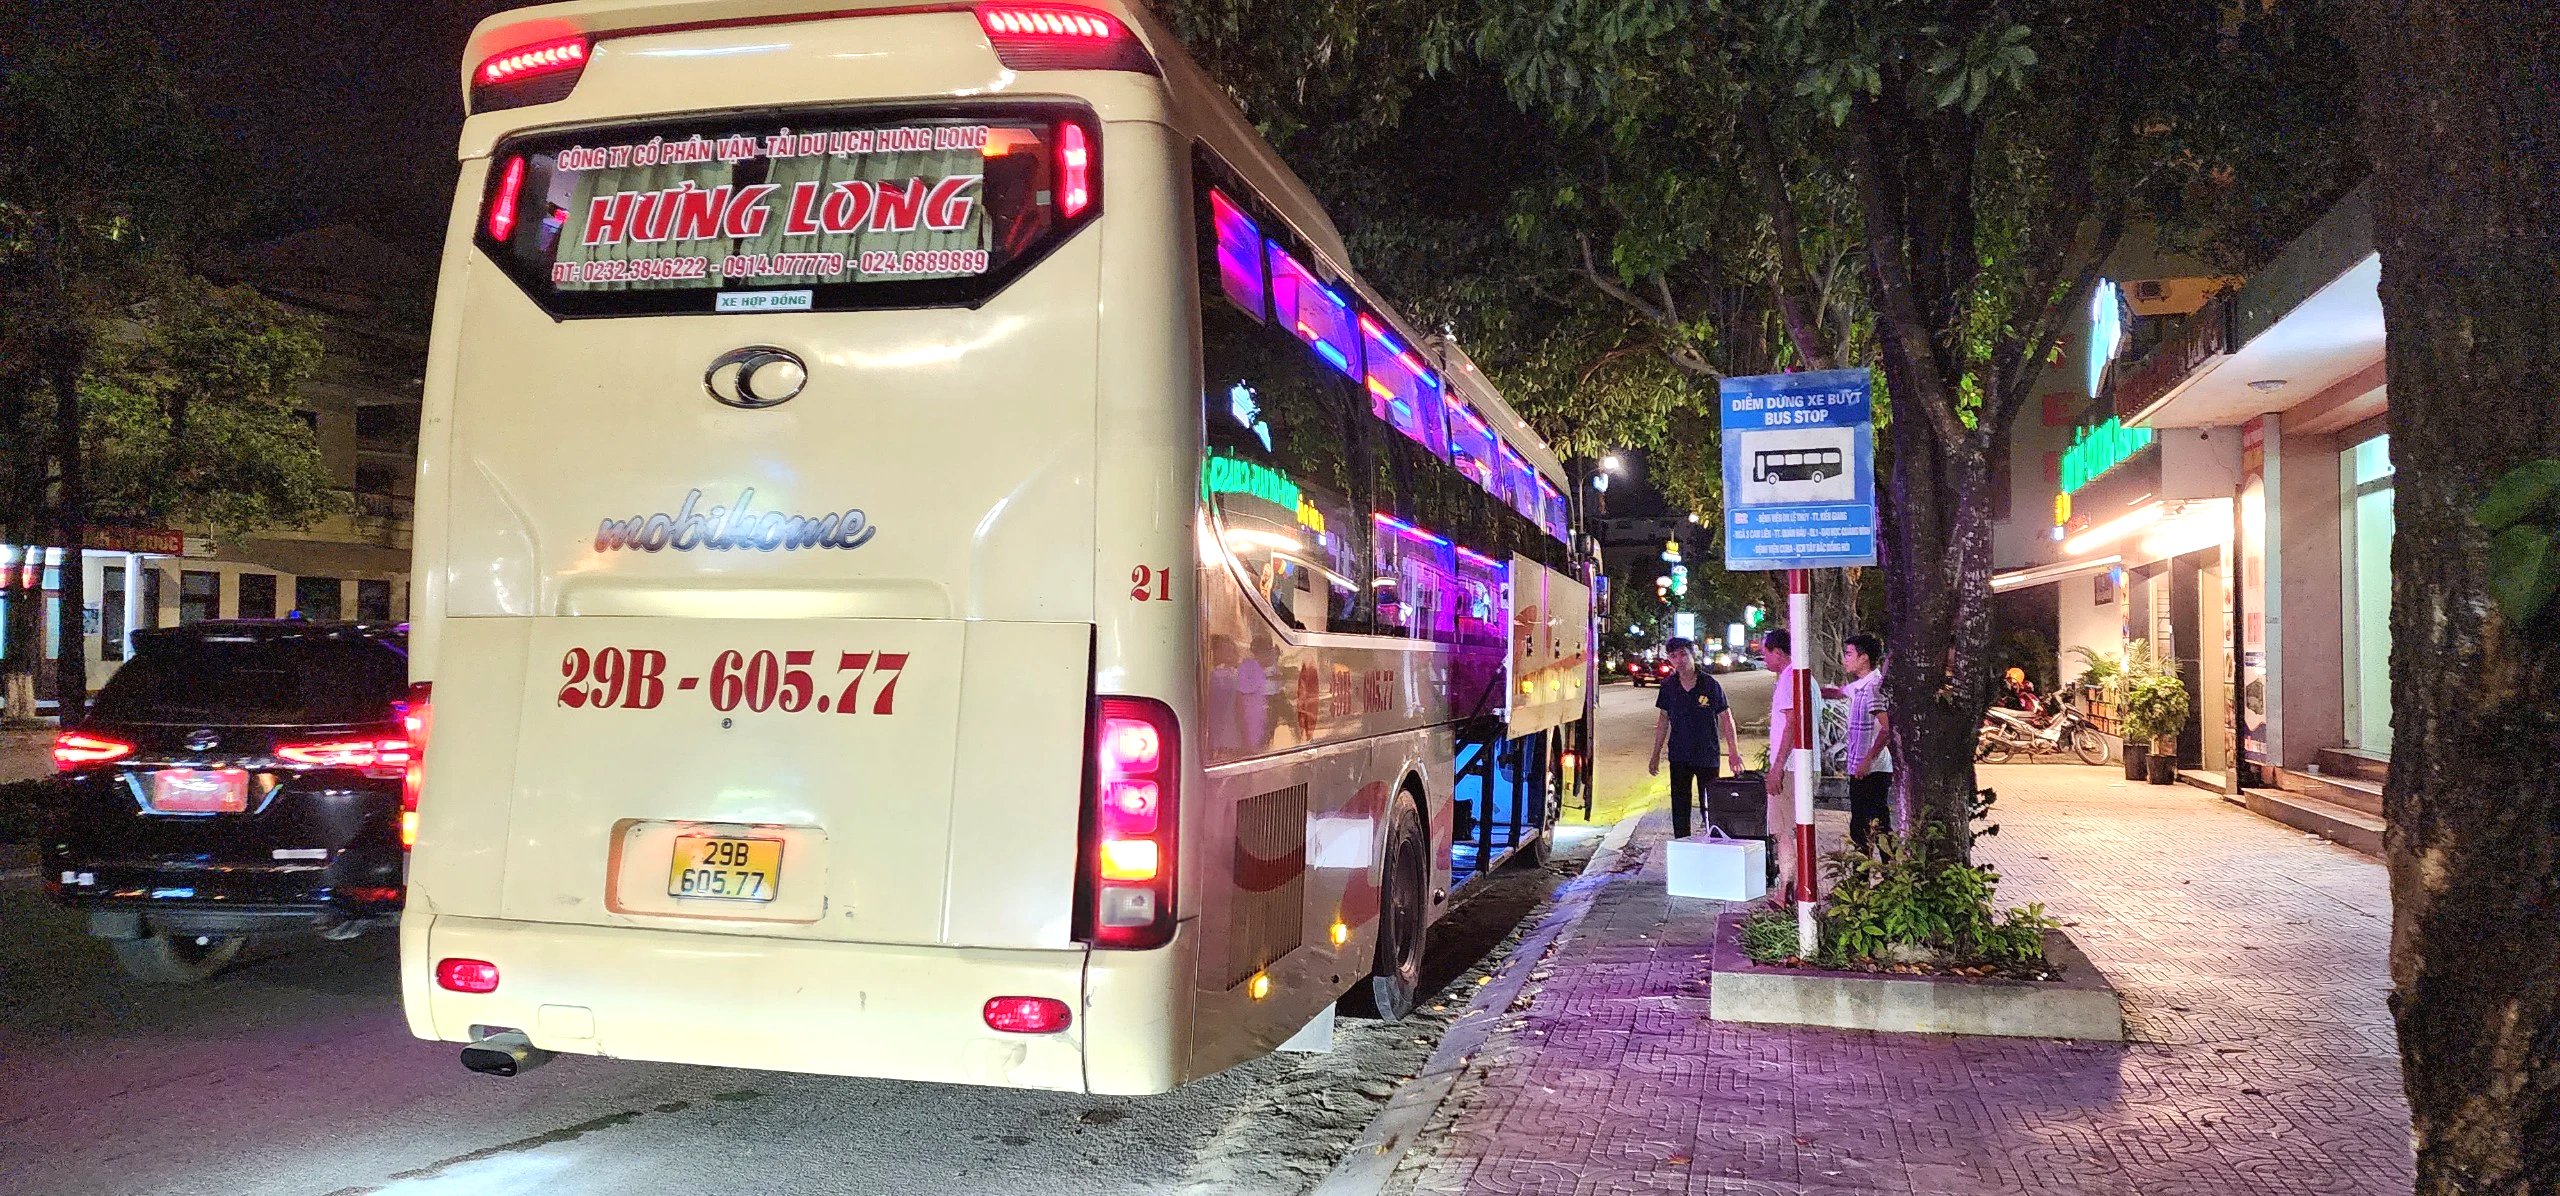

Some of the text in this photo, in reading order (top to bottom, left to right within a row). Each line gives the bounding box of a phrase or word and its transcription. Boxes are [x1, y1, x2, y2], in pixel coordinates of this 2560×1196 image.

[558, 126, 988, 170] CÔNG TY CỔ PHẦN VẬN TẢI DU LỊCH HƯNG LONG
[582, 174, 983, 245] HƯNG LONG
[583, 257, 707, 282] 0232.3846222
[723, 254, 843, 277] 0914.077779
[860, 250, 989, 273] 024.6889889
[722, 297, 737, 306] XE
[1807, 394, 1825, 407] XE
[1764, 409, 1829, 425] BUS STOP
[1129, 564, 1173, 602] 21
[557, 647, 910, 715] 29B - 605.77
[703, 841, 749, 866] 29B
[680, 869, 764, 896] 605.77
